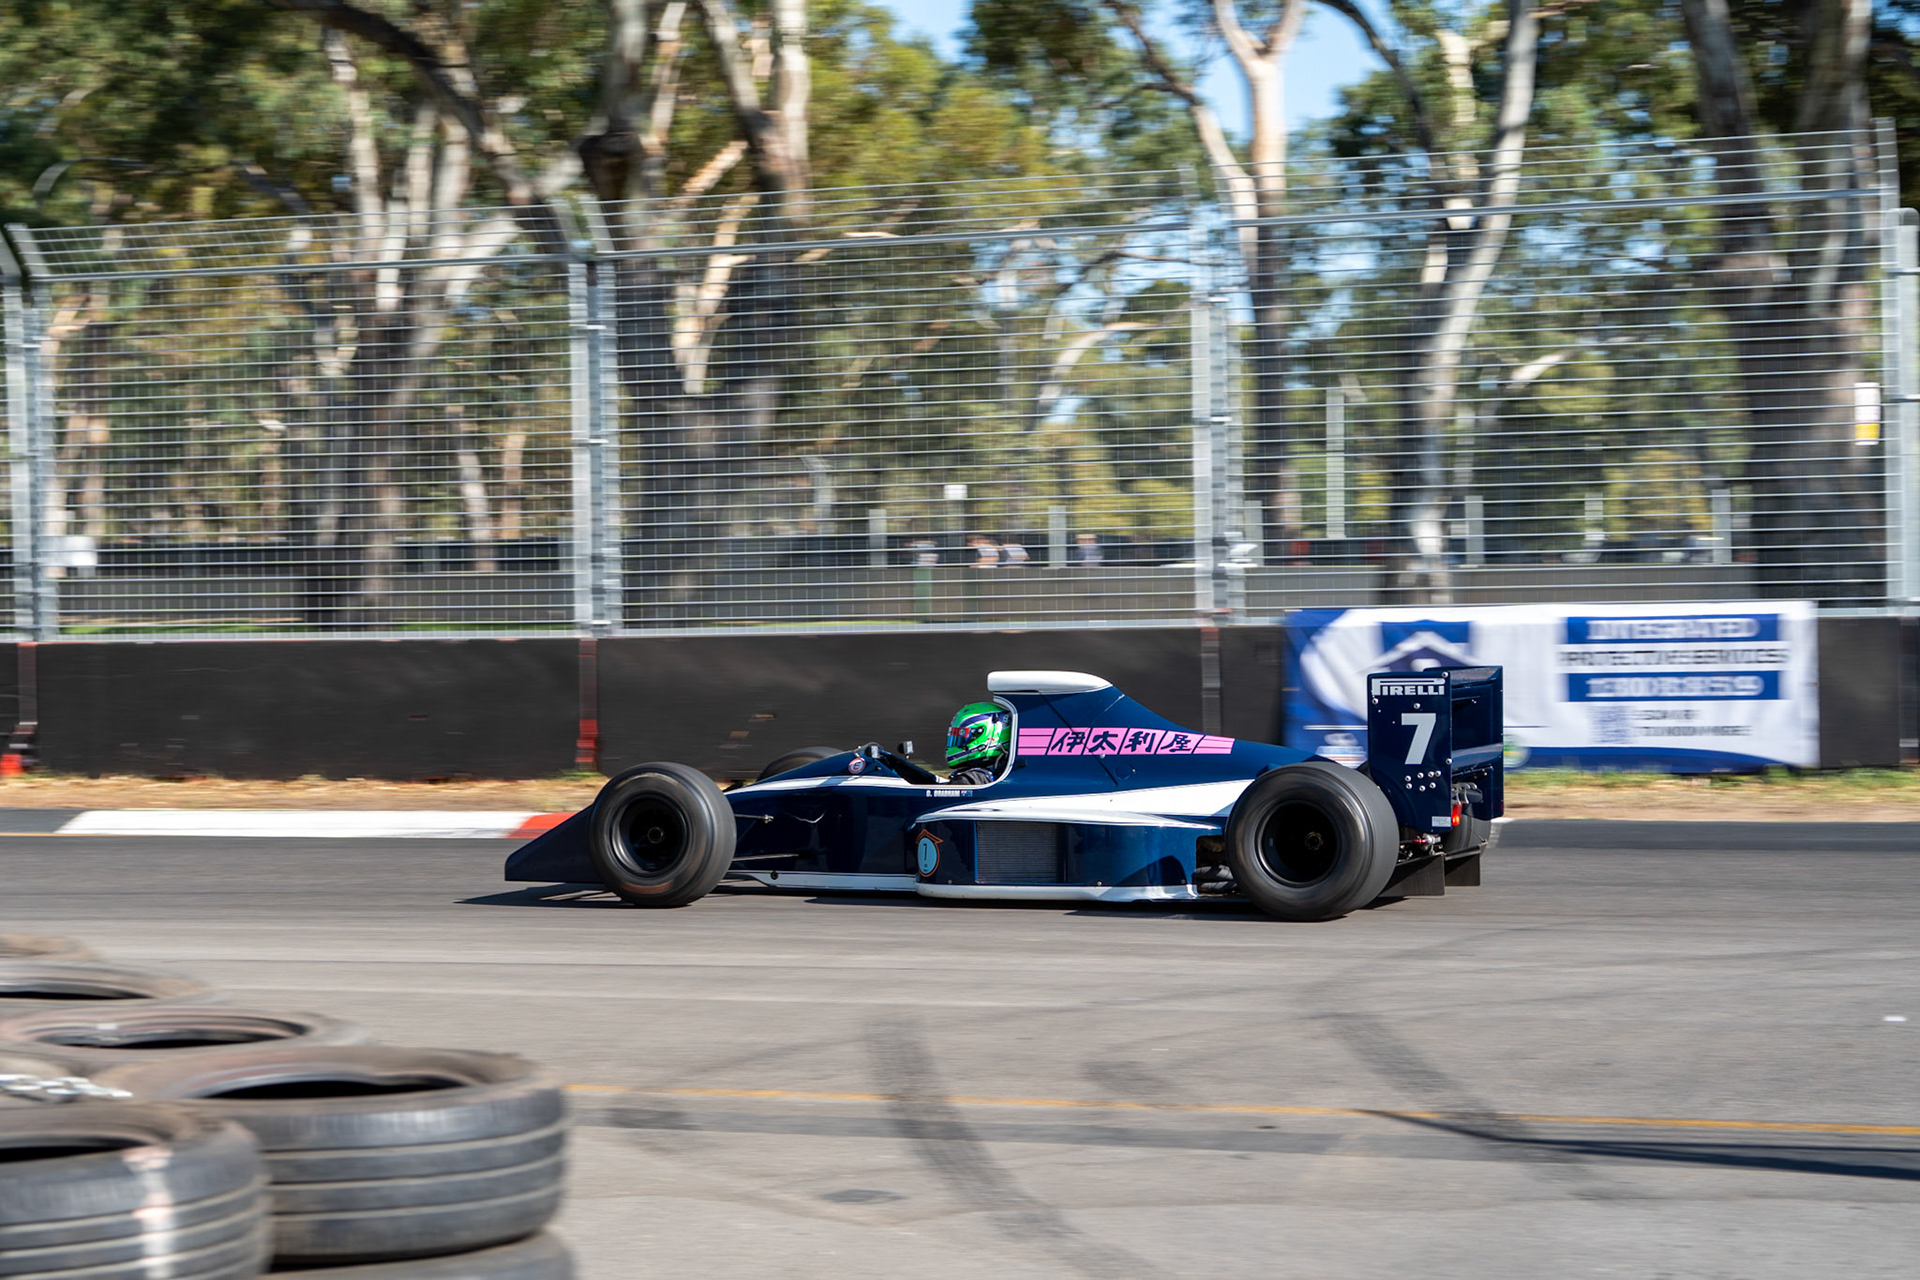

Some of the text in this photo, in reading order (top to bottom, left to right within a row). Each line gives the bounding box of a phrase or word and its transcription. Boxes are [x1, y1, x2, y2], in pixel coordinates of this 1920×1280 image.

[1588, 618, 1759, 640] INTEGRATED
[1560, 649, 1787, 665] PROTECTIVE SERVICES
[1371, 678, 1446, 696] PIRELLI
[1050, 731, 1192, 753] 伊太利屋
[1401, 713, 1436, 765] 7
